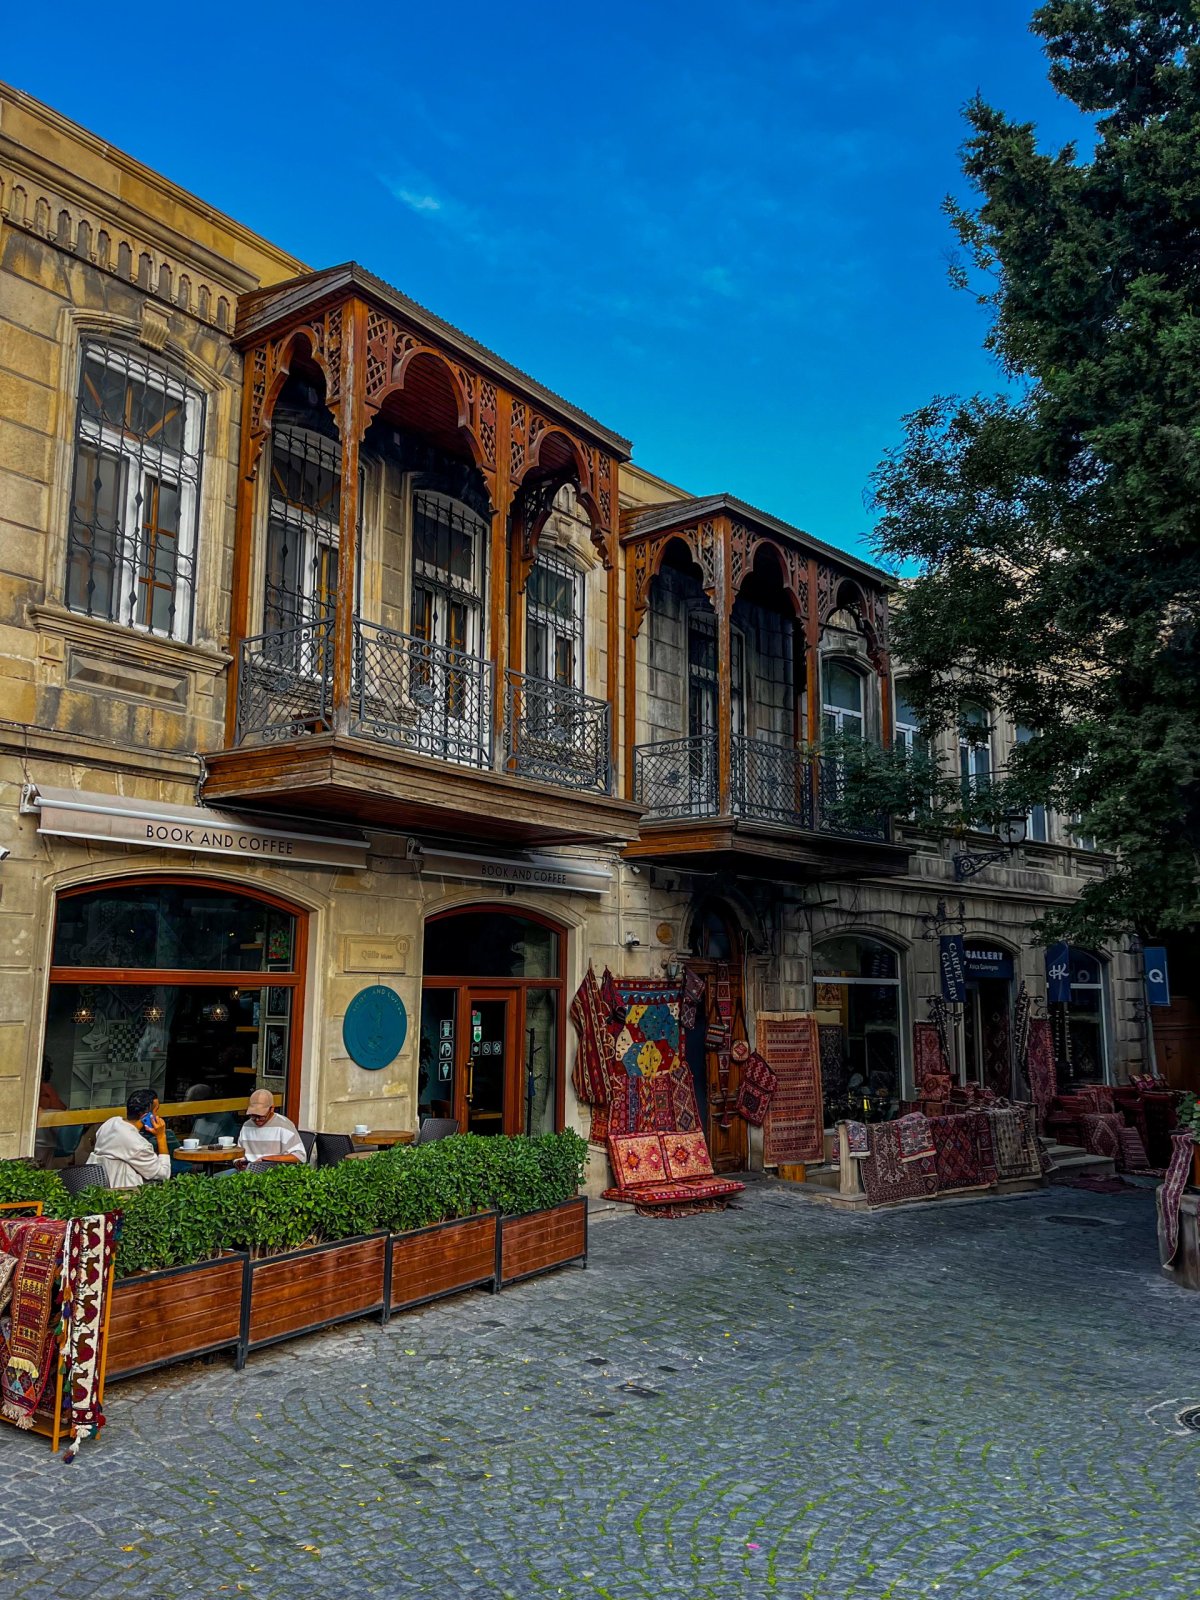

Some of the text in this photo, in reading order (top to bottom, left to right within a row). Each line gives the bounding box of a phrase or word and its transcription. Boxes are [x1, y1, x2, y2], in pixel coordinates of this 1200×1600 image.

[146, 824, 293, 854] BOOK AND COFFEE
[481, 864, 567, 885] BOOK AND COFFEE
[948, 942, 965, 984] CARPET
[964, 949, 1003, 961] GALLERY
[941, 952, 959, 1001] GALLERY
[1148, 968, 1164, 983] Q
